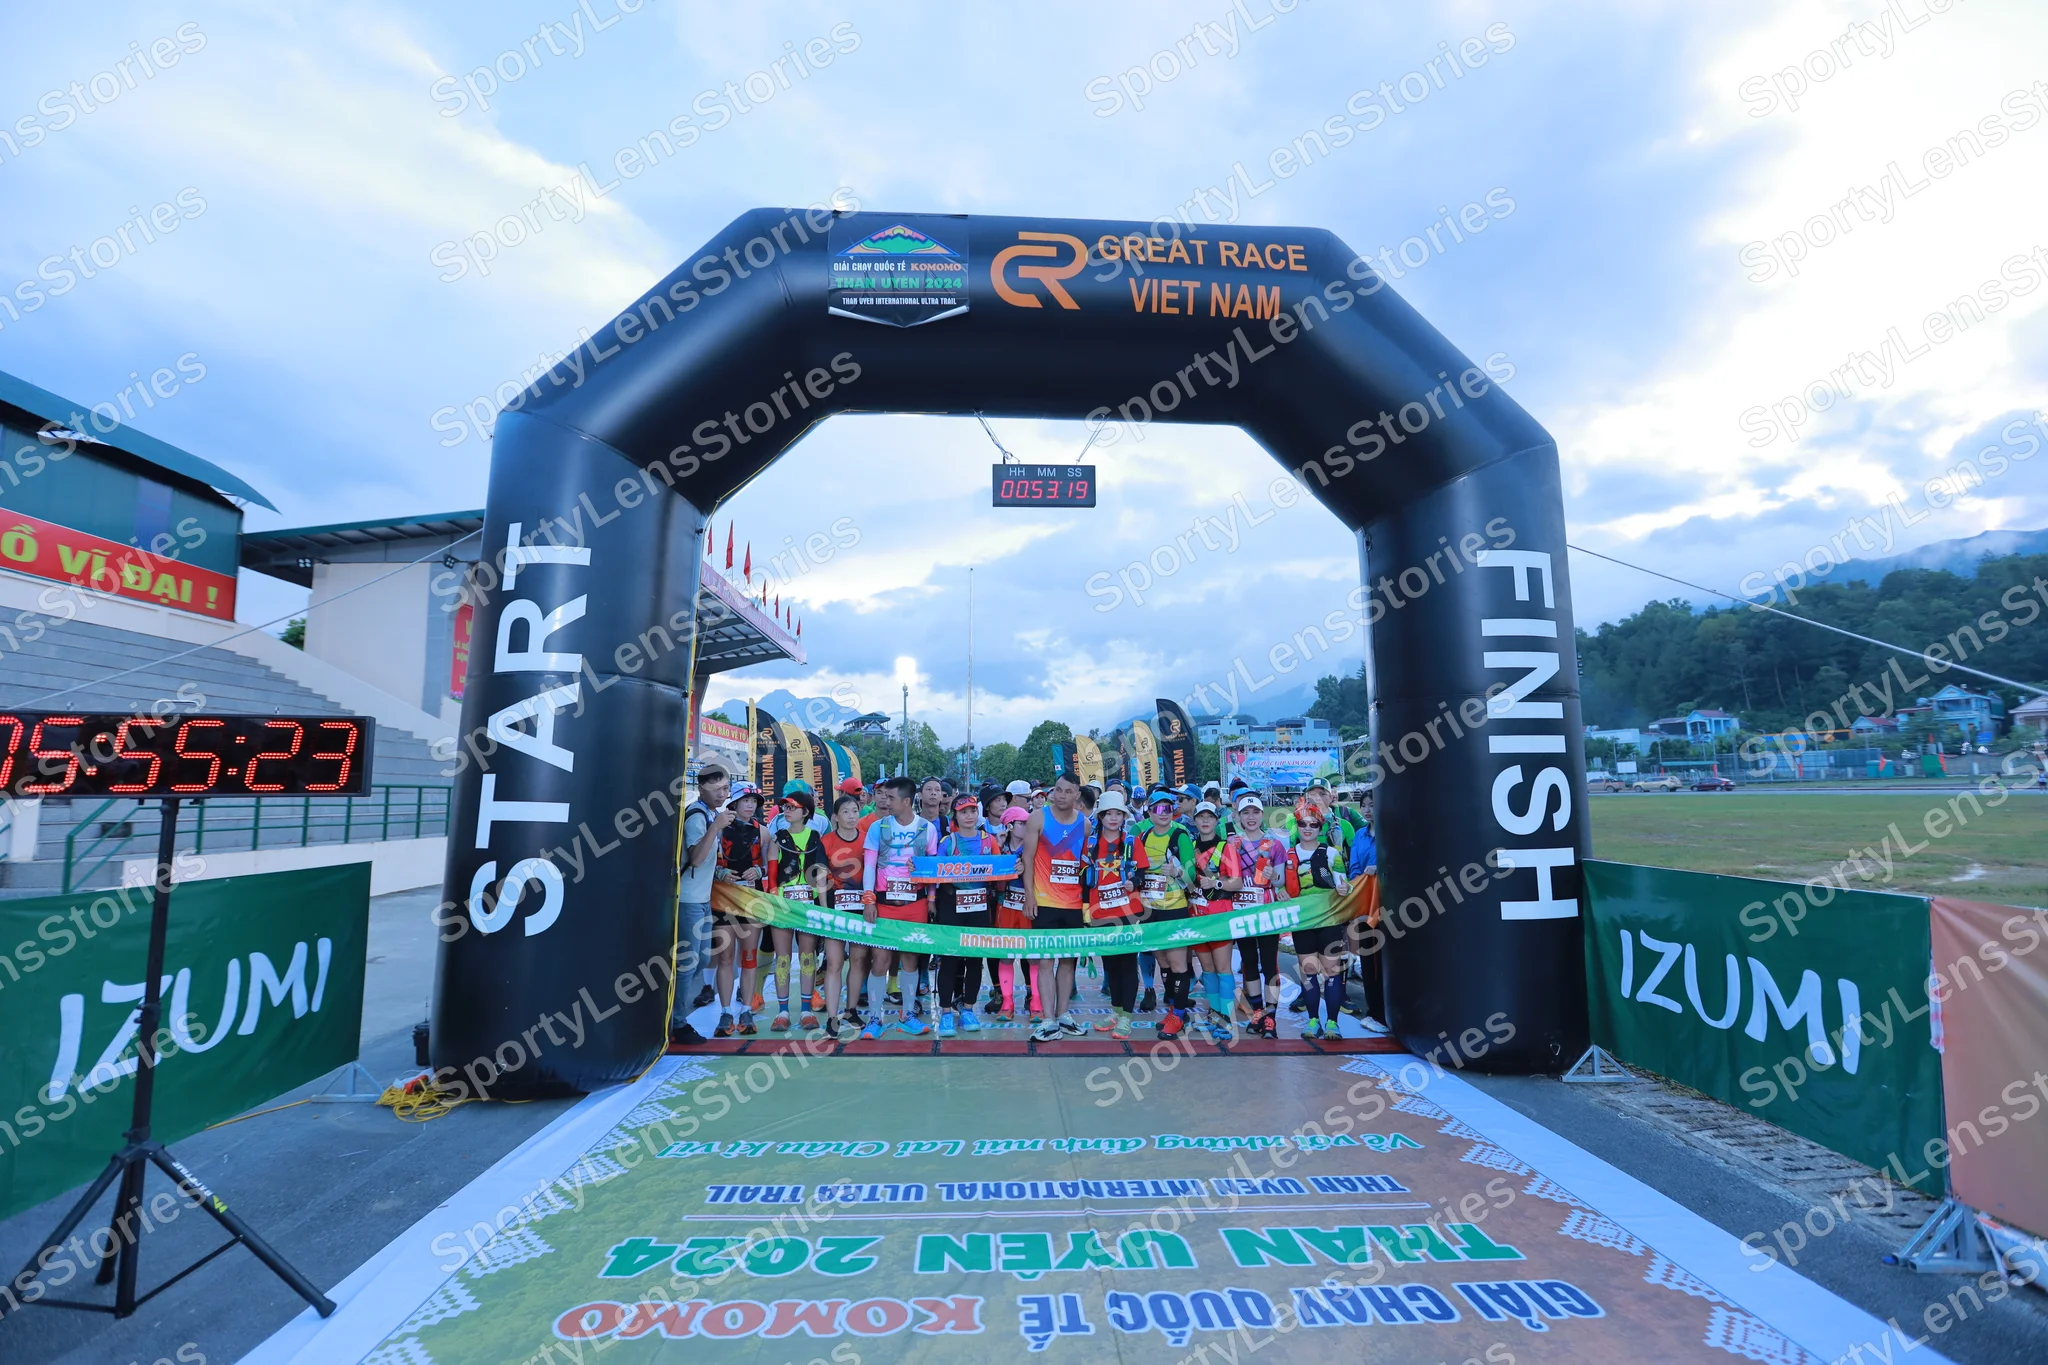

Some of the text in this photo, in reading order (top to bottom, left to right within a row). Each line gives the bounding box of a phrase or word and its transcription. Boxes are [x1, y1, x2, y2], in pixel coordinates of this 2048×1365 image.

[1098, 234, 1308, 272] GREAT RACE
[833, 259, 962, 273] GIẢI CHẠY QUỐC TẾ KOMOMO
[835, 277, 876, 289] THAN
[925, 277, 963, 289] 2024
[842, 297, 957, 305] THAN UYEN INTERNATIONAL ULTRA TRAIL
[1128, 277, 1282, 321] VIET NAM
[1009, 467, 1083, 477] HH MM SS
[57, 542, 112, 582] VĨ
[120, 557, 193, 603] ĐẠI
[469, 521, 592, 938] START
[1476, 549, 1579, 921] FINISH
[937, 862, 972, 877] 1983
[1057, 866, 1075, 875] 2506
[892, 882, 912, 891] 2574
[1144, 880, 1160, 889] 2556
[841, 894, 860, 902] 2558
[963, 895, 982, 903] 2575
[1103, 889, 1122, 899] 2589
[1239, 893, 1257, 901] 2503
[1619, 928, 1861, 1075] IZUMI
[49, 937, 332, 1102] IZUMI
[777, 1140, 890, 1159] Châu
[896, 1139, 965, 1158] Lai
[973, 1138, 1044, 1156] núi
[1150, 1133, 1285, 1153] những
[703, 1174, 1410, 1205] THAN UYEN INTERNATIONAL ULTRA TRAIL
[599, 1223, 1527, 1281] THAN UYÊN 2024
[552, 1277, 1606, 1352] GIẢI CHẠY QUỐC TẾ KOMOMO
